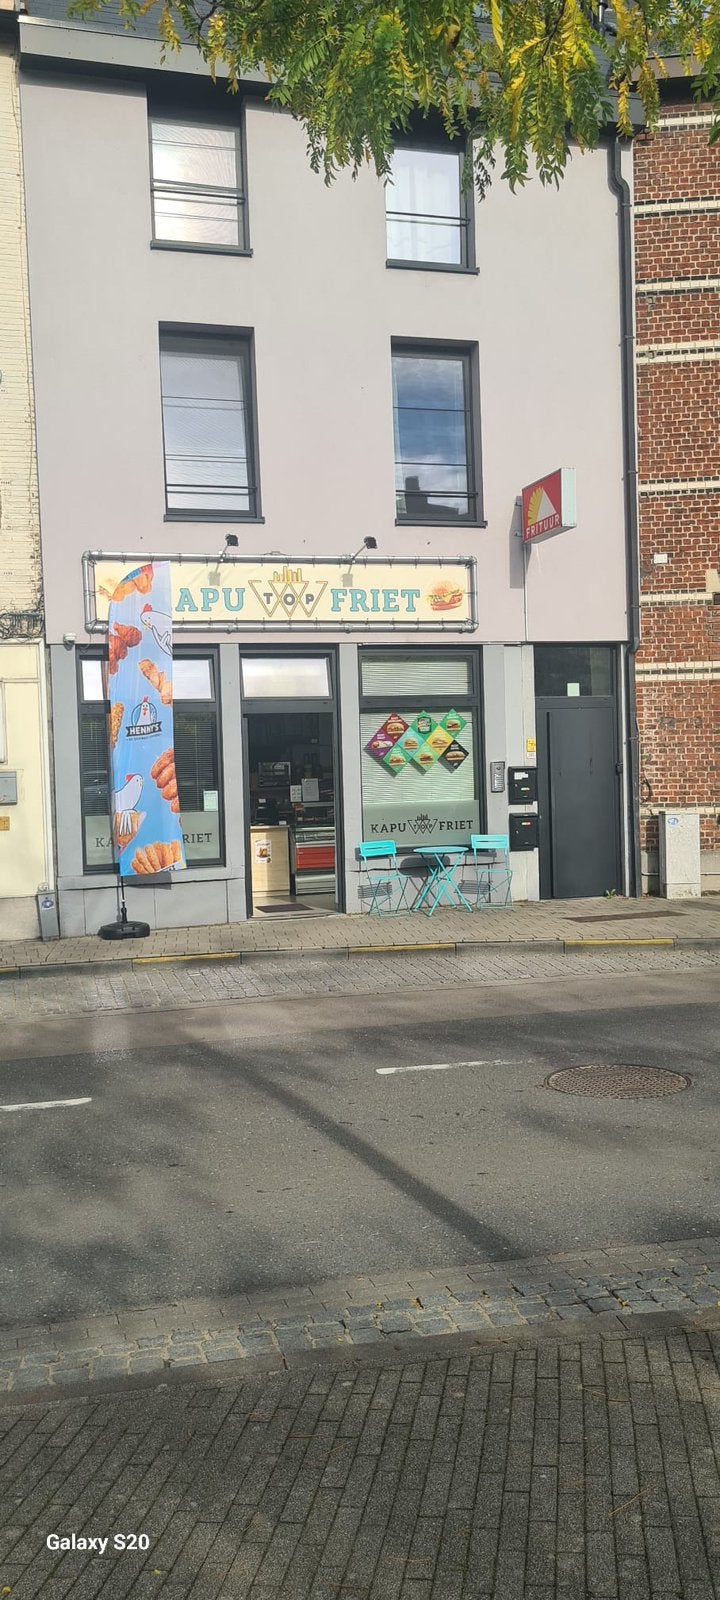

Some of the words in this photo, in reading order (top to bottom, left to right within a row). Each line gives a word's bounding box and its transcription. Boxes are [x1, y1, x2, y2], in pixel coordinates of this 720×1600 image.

[526, 514, 560, 538] FRITUUR
[175, 587, 245, 611] APU
[263, 592, 314, 606] TOP
[330, 588, 421, 612] FRIET
[129, 723, 160, 735] HENNY'S
[370, 823, 406, 833] KAPU
[439, 820, 474, 830] FRIET
[95, 836, 113, 847] KA
[182, 832, 213, 844] RIET
